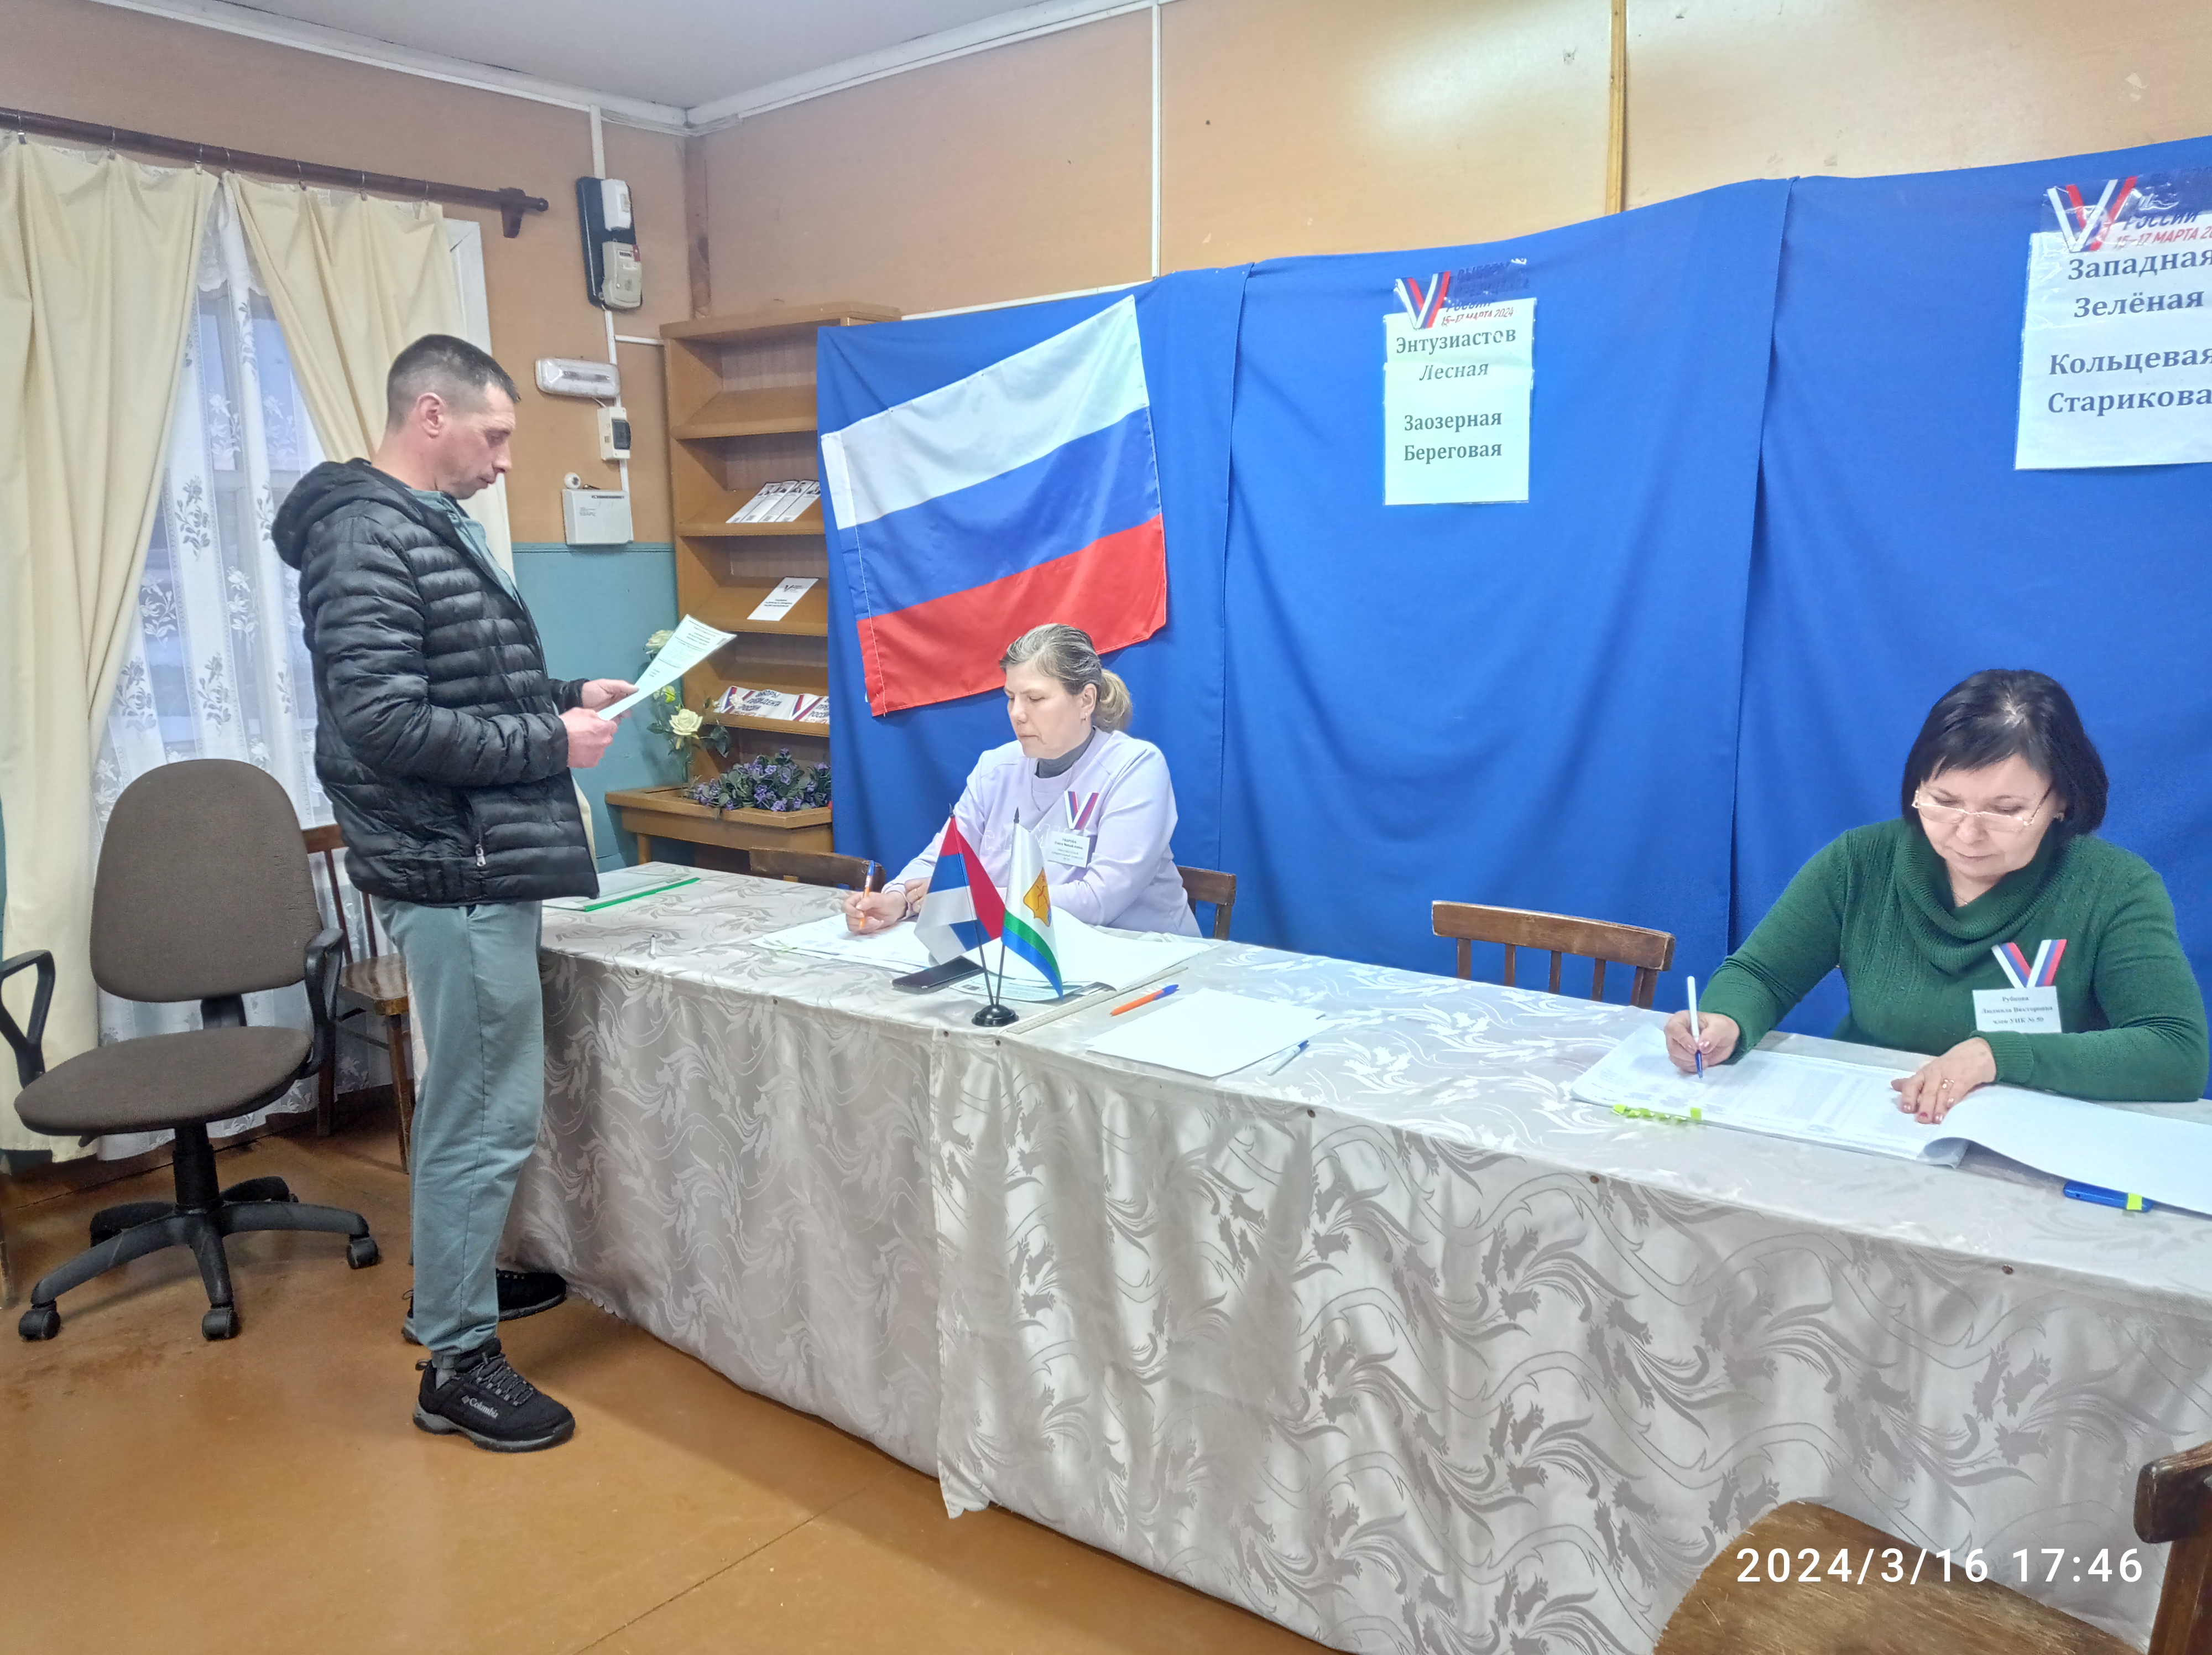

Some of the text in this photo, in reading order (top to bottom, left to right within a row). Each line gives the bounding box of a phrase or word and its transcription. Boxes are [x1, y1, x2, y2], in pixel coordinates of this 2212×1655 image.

[2152, 227, 2199, 243] МАРТА
[2068, 249, 2212, 280] Западная
[1493, 307, 1514, 319] 2024
[2074, 291, 2204, 318] Зелёная
[1395, 329, 1516, 355] Энтузиастов
[1419, 363, 1489, 381] Лесная
[2049, 348, 2212, 375] Кольцевая
[2048, 389, 2212, 416] Старикова
[1404, 412, 1503, 433] Заозерная
[1404, 443, 1503, 465] Береговая
